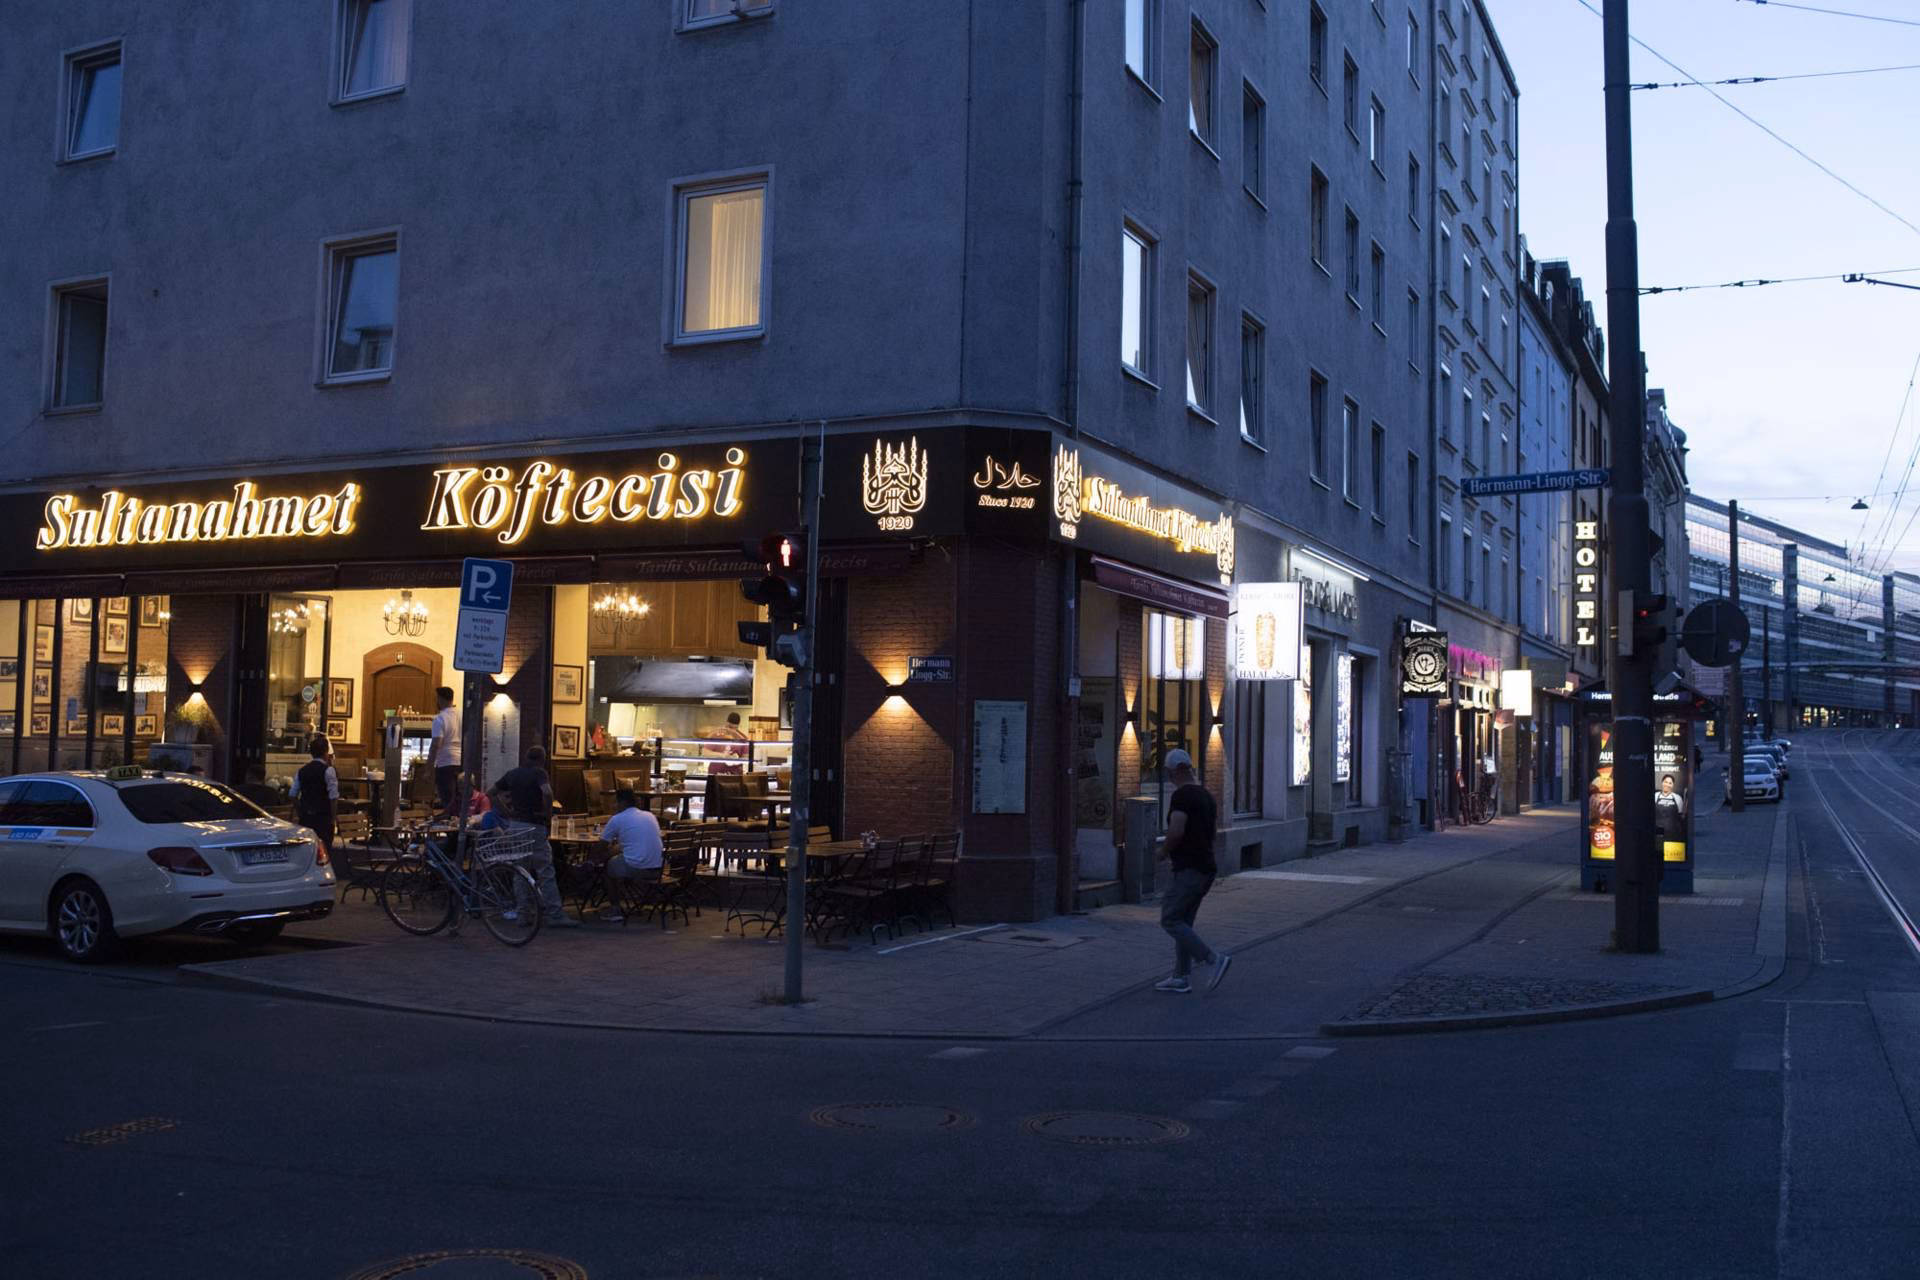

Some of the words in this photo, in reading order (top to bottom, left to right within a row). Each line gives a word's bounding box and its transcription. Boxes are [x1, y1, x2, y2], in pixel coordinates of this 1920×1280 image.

[973, 455, 1042, 489] حلال
[1469, 471, 1602, 493] Hermann-Lingg-Str.
[36, 481, 359, 550] Sultanahmet
[420, 448, 745, 544] Köftecisi
[977, 495, 1008, 508] Since
[1009, 496, 1036, 509] 1920
[1087, 476, 1173, 538] Sultanahmet
[877, 516, 914, 531] 1920
[468, 564, 497, 602] P
[1575, 521, 1597, 645] HOTEL
[1591, 692, 1612, 700] Herm
[1654, 753, 1676, 763] LAND
